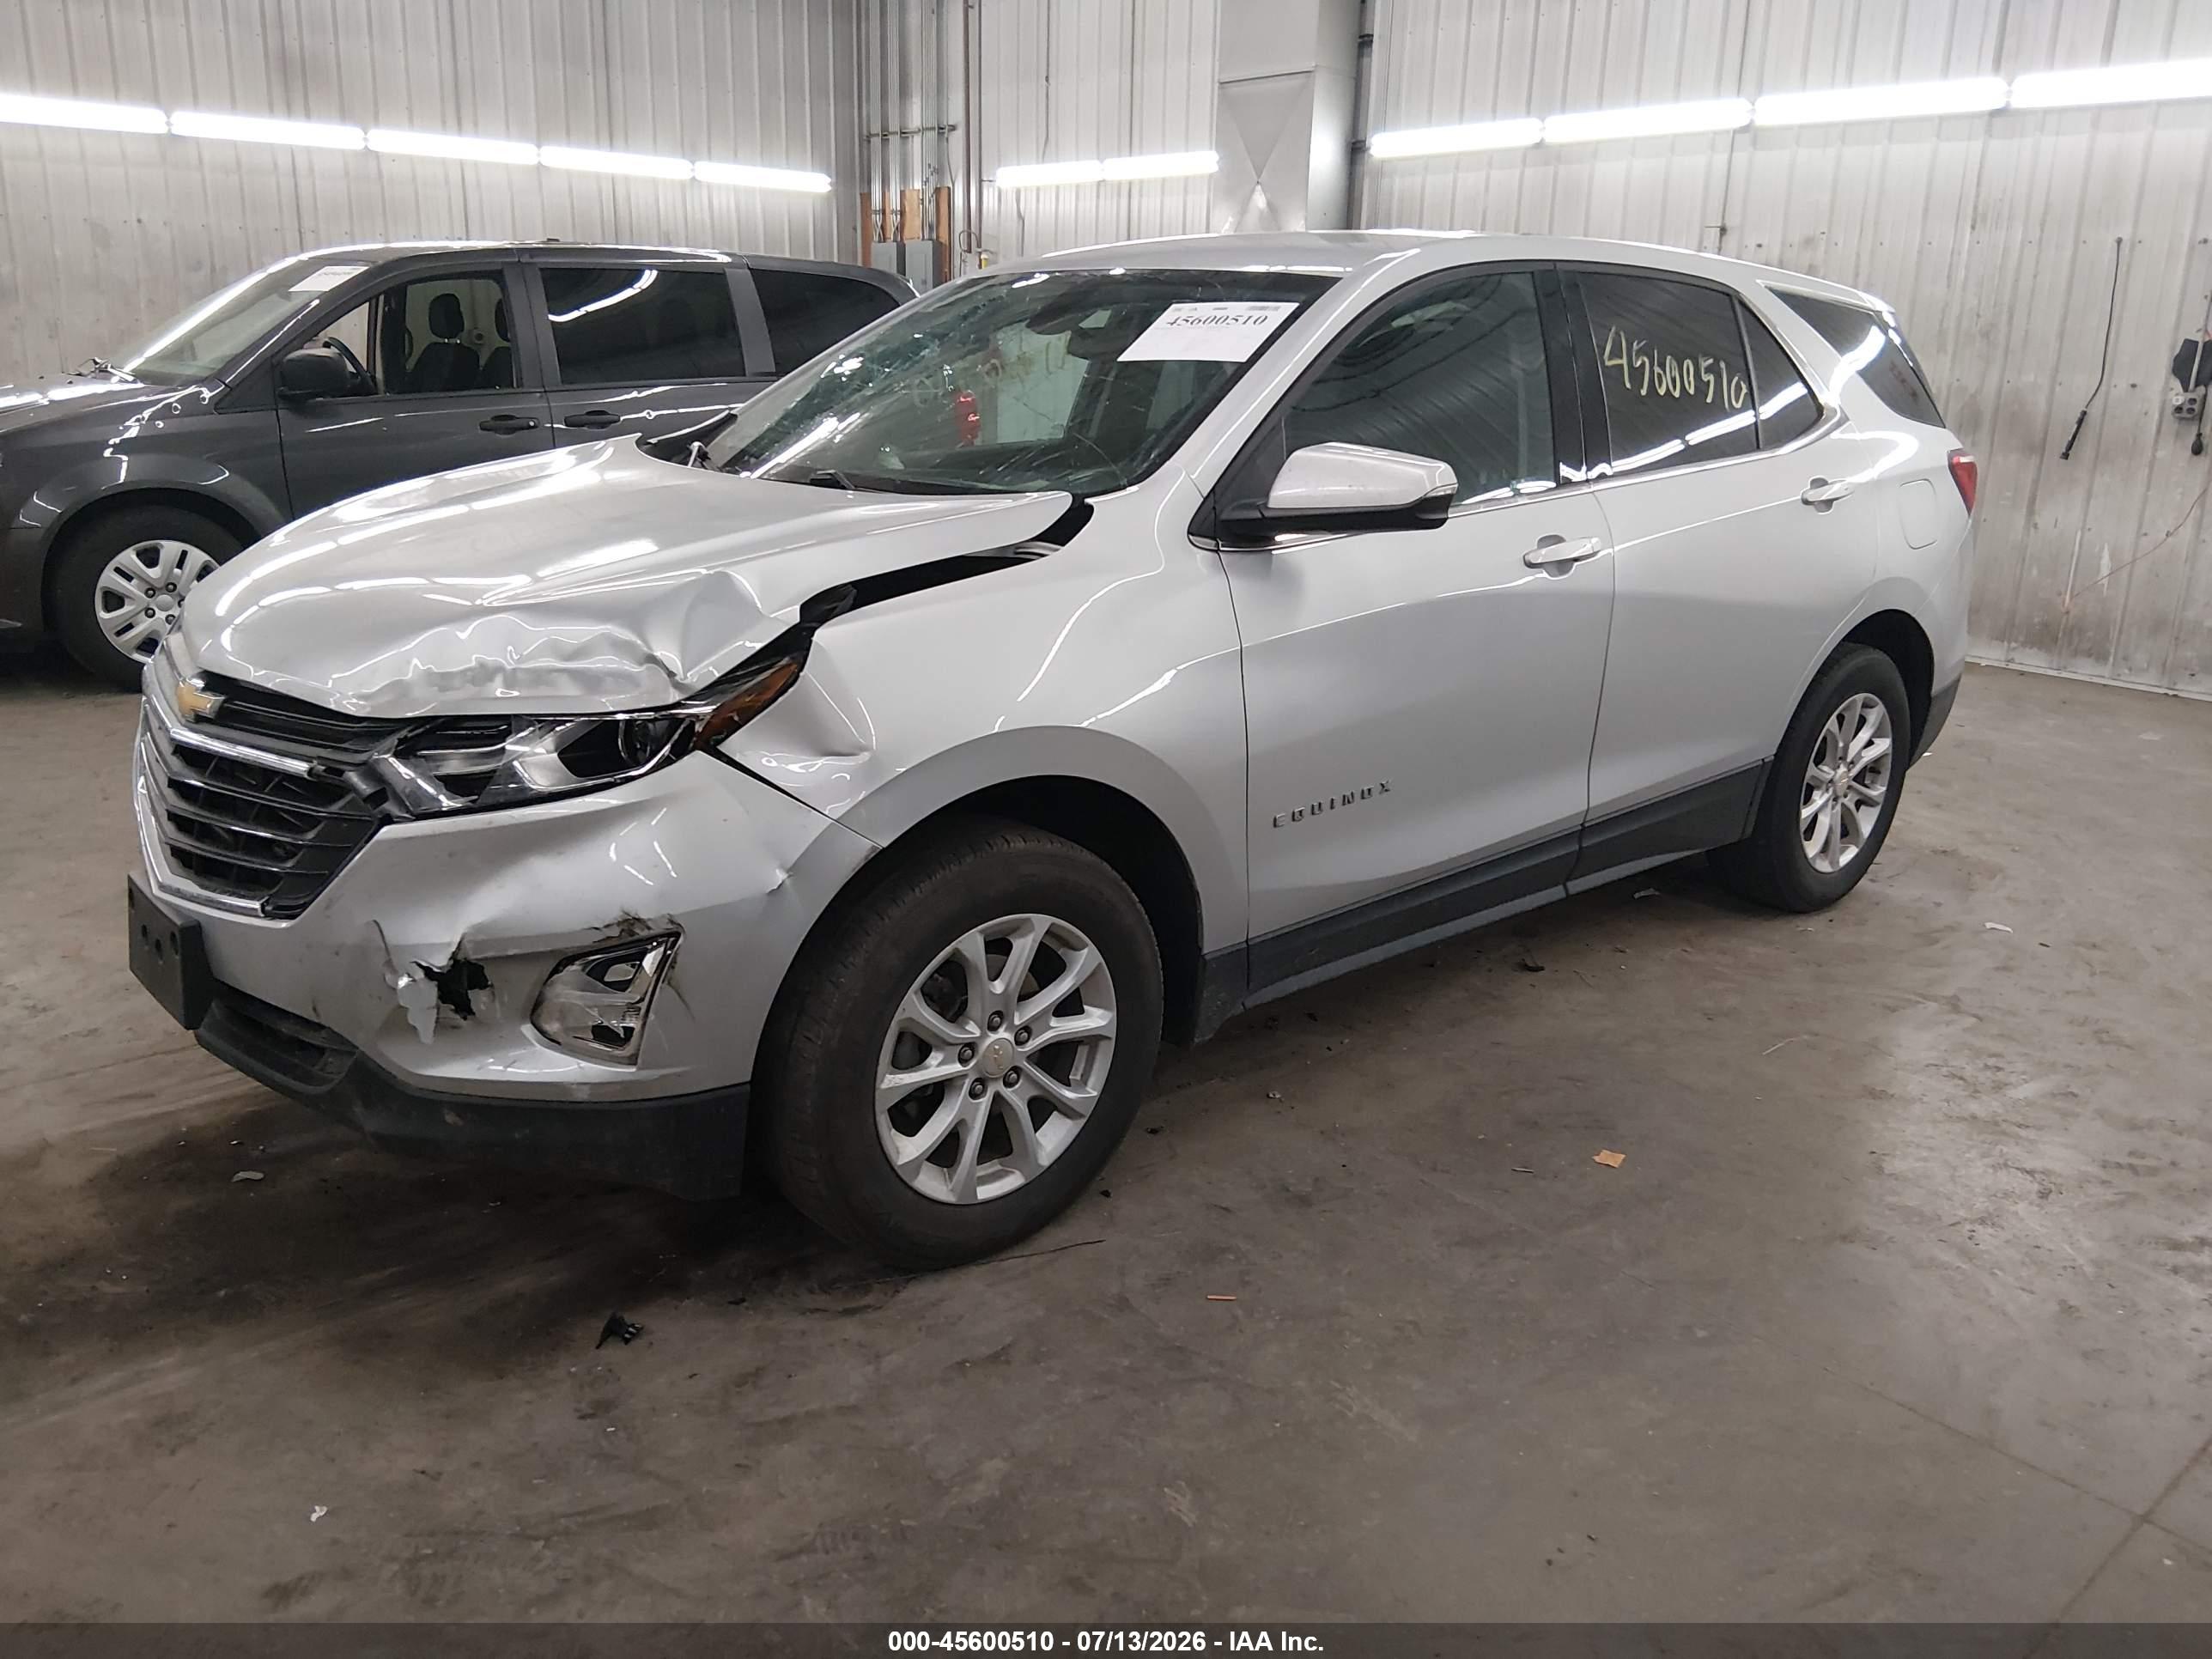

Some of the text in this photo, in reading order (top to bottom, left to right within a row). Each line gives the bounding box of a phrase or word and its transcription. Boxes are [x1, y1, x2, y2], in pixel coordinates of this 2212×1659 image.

[1166, 314, 1268, 326] 45600510
[1603, 325, 1749, 412] 45600510
[1273, 780, 1393, 829] EQUINOX
